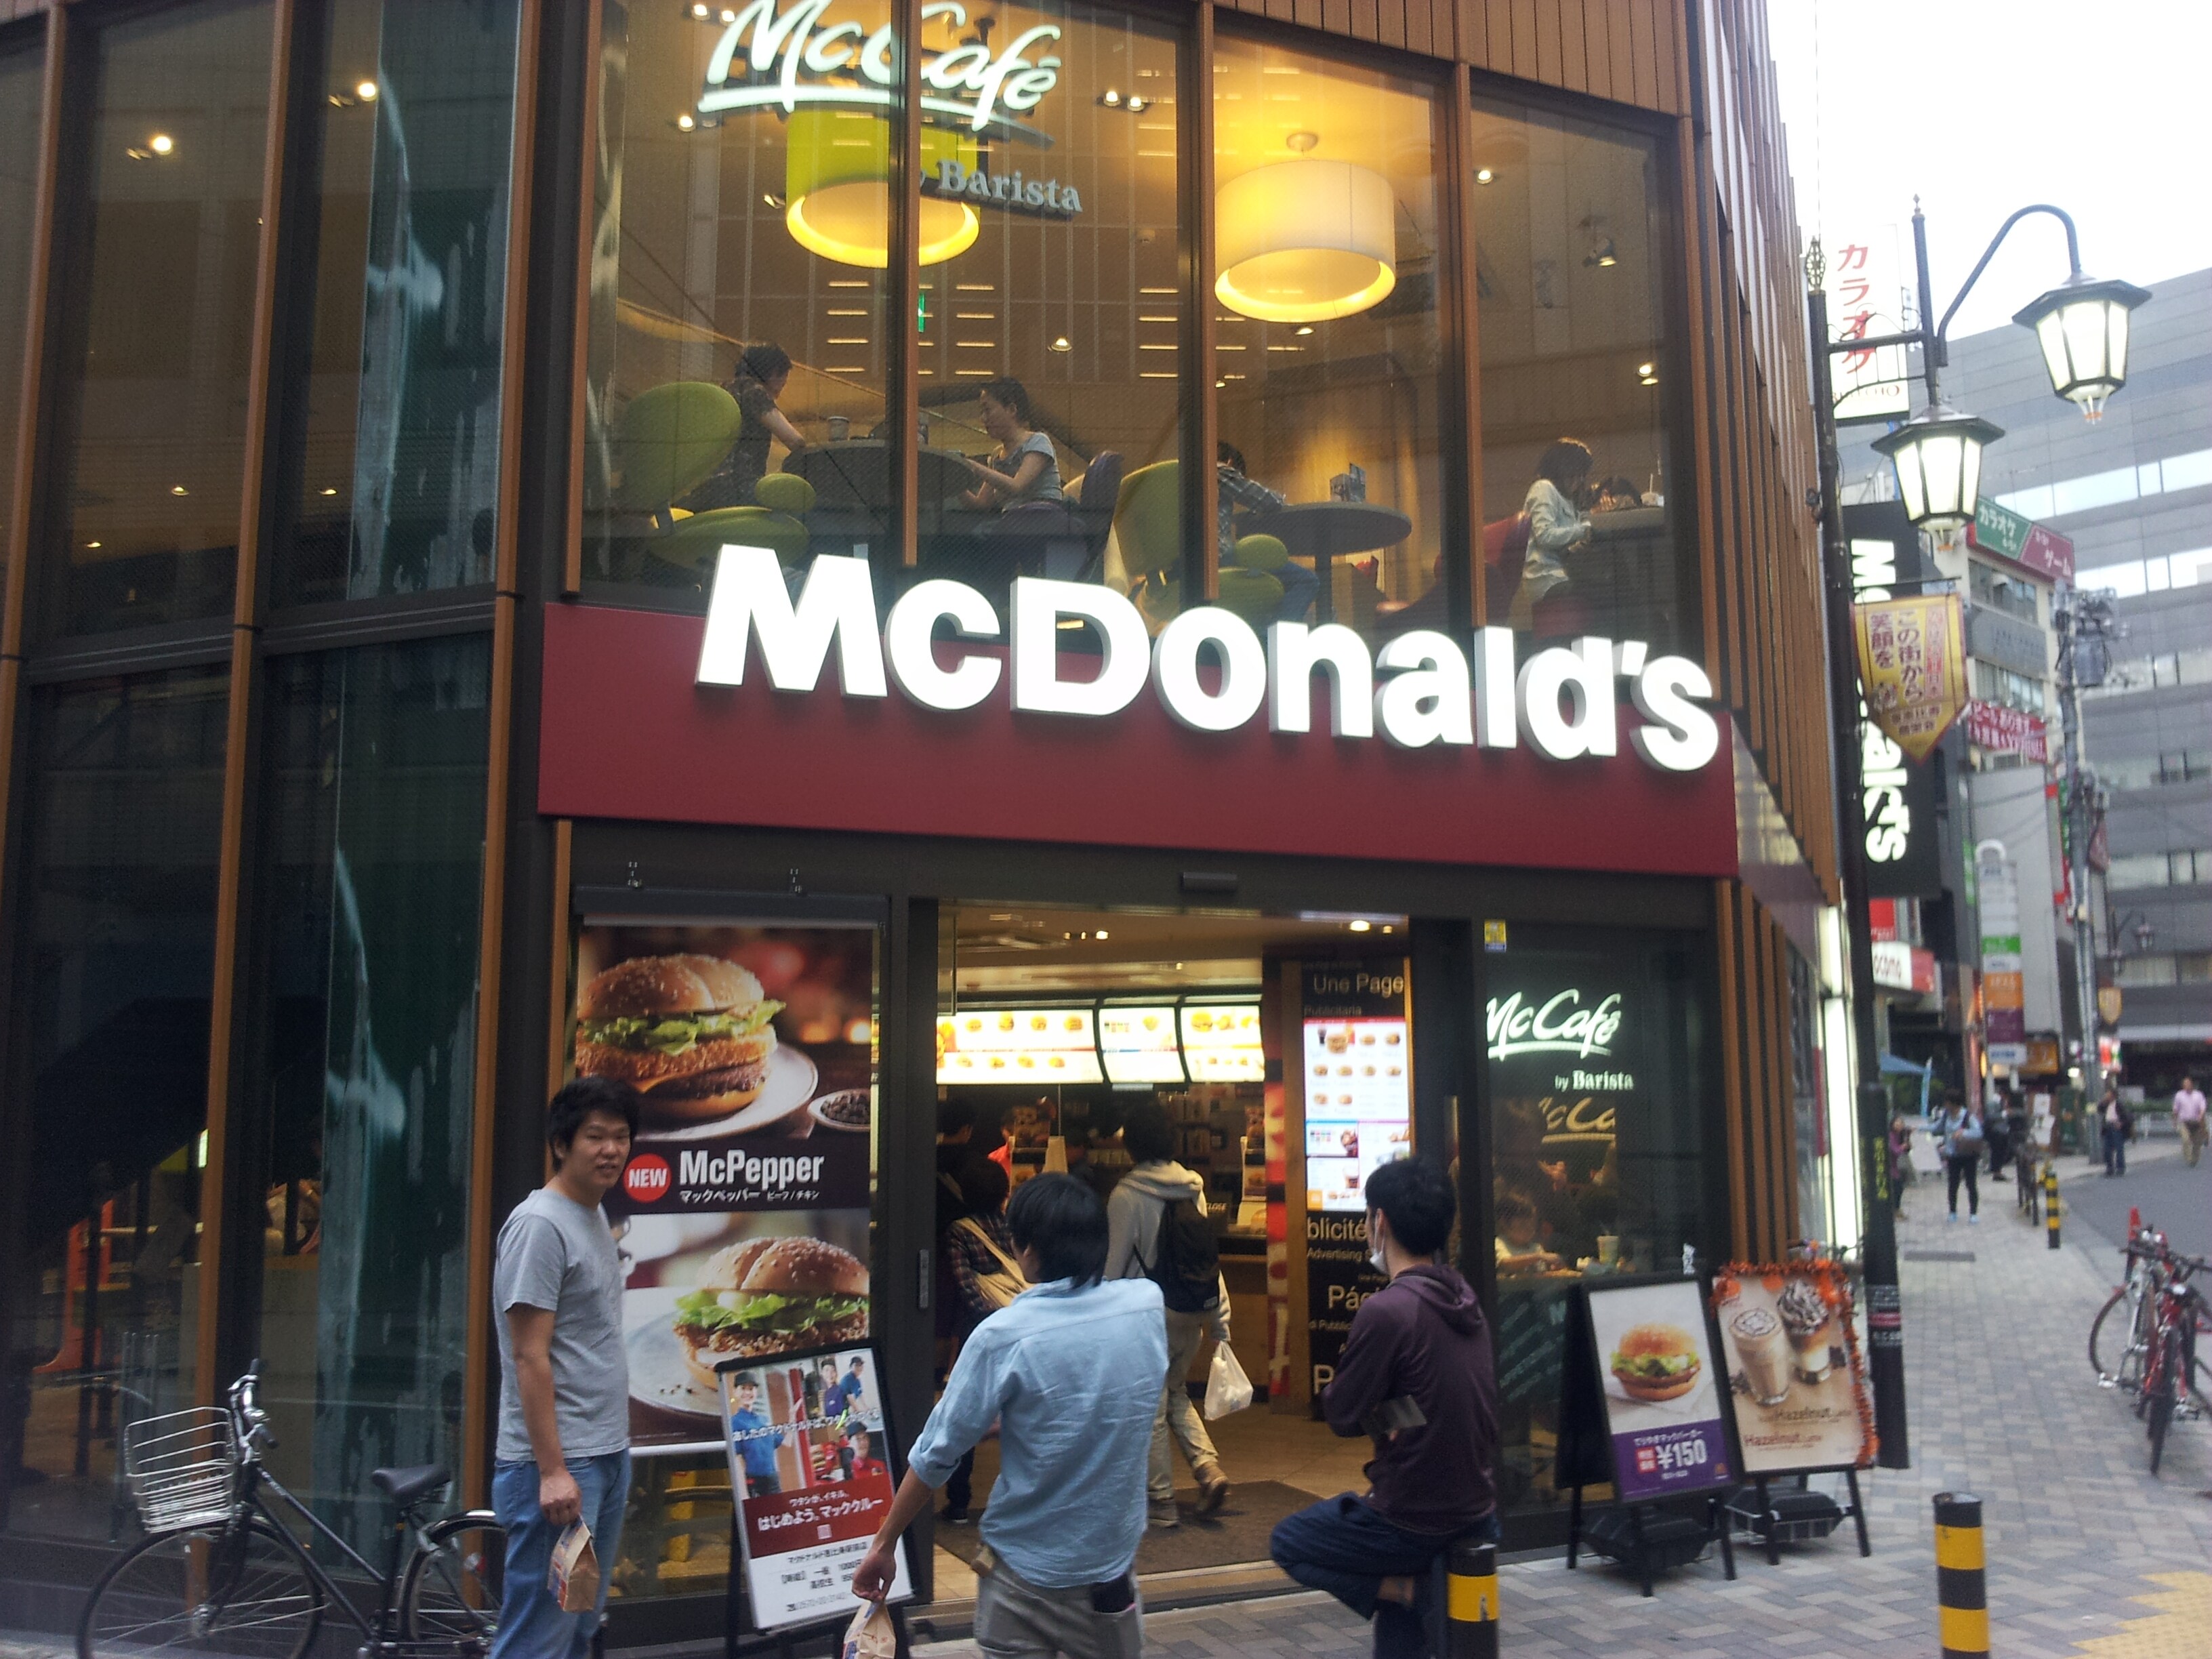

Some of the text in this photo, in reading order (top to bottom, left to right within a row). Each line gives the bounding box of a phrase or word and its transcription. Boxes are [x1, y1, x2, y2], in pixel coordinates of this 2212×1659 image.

[698, 0, 1062, 132] McCafé
[937, 159, 1083, 213] Barista
[695, 544, 1719, 773] McDonald's
[1355, 972, 1405, 999] Page
[1555, 1069, 1635, 1092] by Barista
[628, 1167, 668, 1187] NEW
[679, 1149, 825, 1191] McPepper
[679, 1187, 761, 1204] マックペッパー
[1307, 1248, 1361, 1262] Advertising
[1656, 1438, 1708, 1469] ¥150
